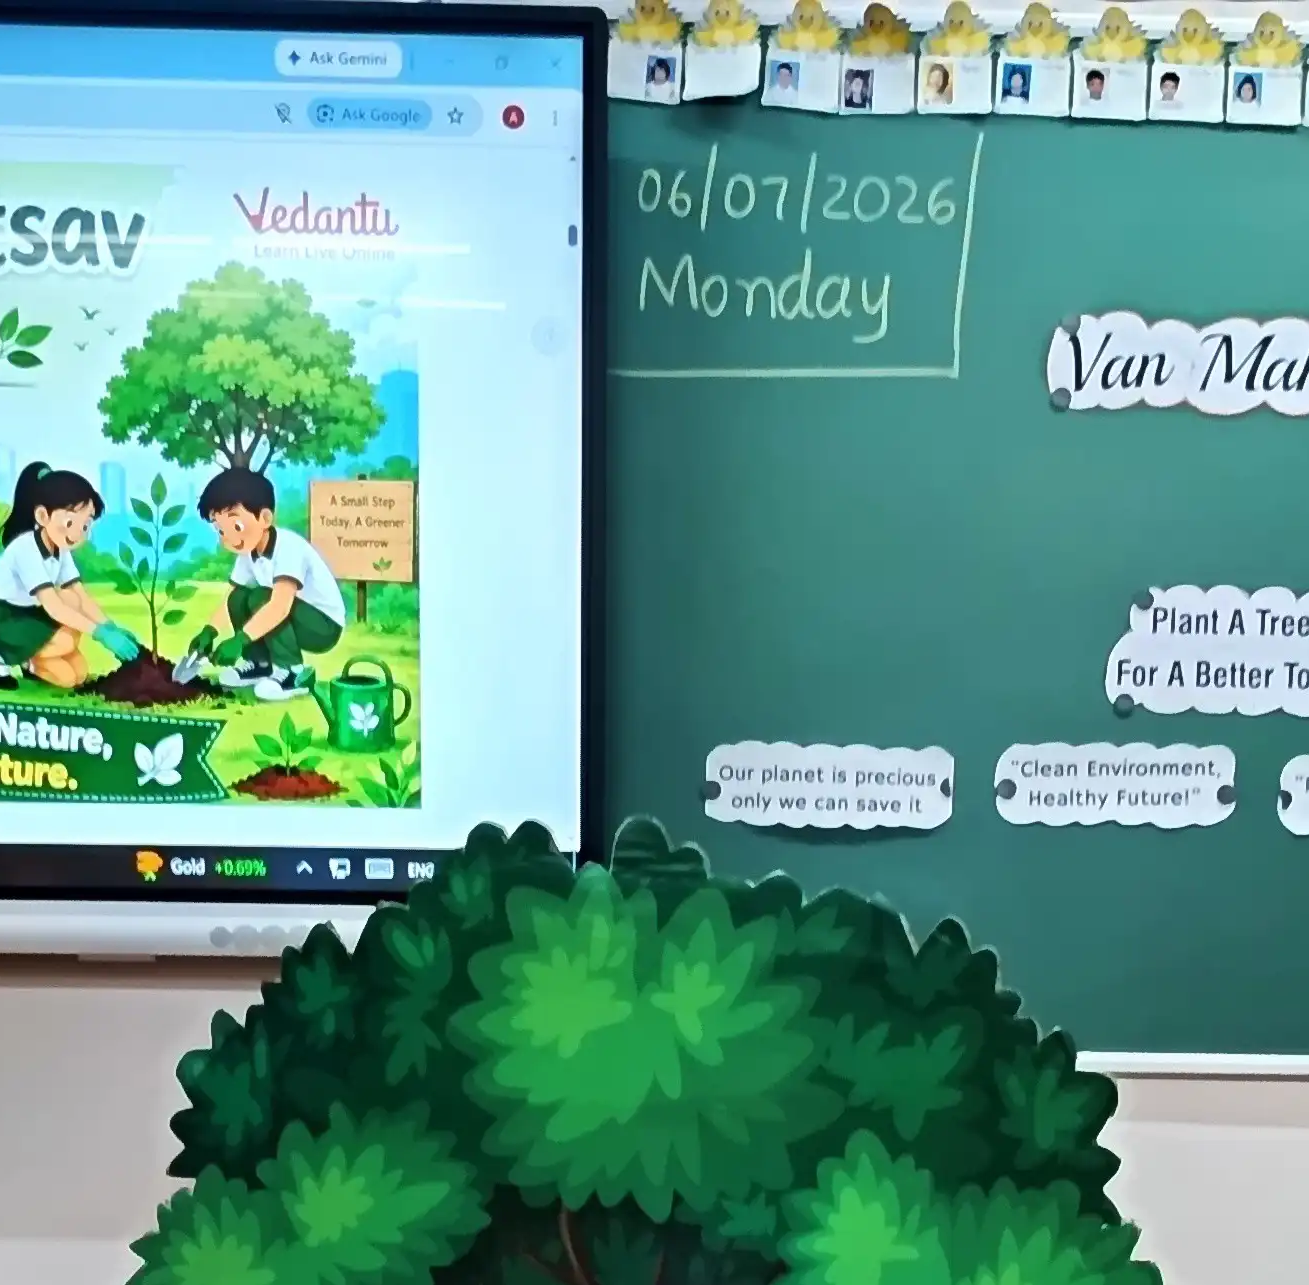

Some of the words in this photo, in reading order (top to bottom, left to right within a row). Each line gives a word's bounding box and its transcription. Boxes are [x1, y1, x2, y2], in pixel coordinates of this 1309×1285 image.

[309, 51, 334, 65] Ask
[339, 52, 387, 66] Gemini
[342, 108, 366, 121] Ask
[371, 109, 421, 126] Google
[637, 142, 956, 233] 06/07/2026
[233, 187, 399, 236] Vedantu
[639, 247, 891, 344] Monday
[1068, 331, 1176, 393] Van
[330, 495, 338, 507] A
[341, 496, 368, 508] Small
[372, 496, 396, 510] Step
[355, 517, 363, 528] A
[366, 517, 405, 528] Greener
[337, 537, 389, 549] Tomorrow
[1152, 607, 1218, 637] Plant
[1228, 609, 1245, 636] A
[1116, 659, 1158, 687] For
[1167, 661, 1185, 688] A
[1195, 661, 1274, 690] Better
[719, 765, 754, 783] Our
[762, 766, 825, 786] planet
[832, 766, 847, 784] is
[855, 770, 936, 790] precious
[1087, 760, 1221, 781] Environment,
[730, 793, 771, 815] only
[779, 797, 807, 813] we
[814, 797, 849, 812] can
[857, 798, 901, 814] save
[908, 796, 922, 814] it
[1028, 788, 1109, 810] Healthy
[170, 857, 206, 876] Gold
